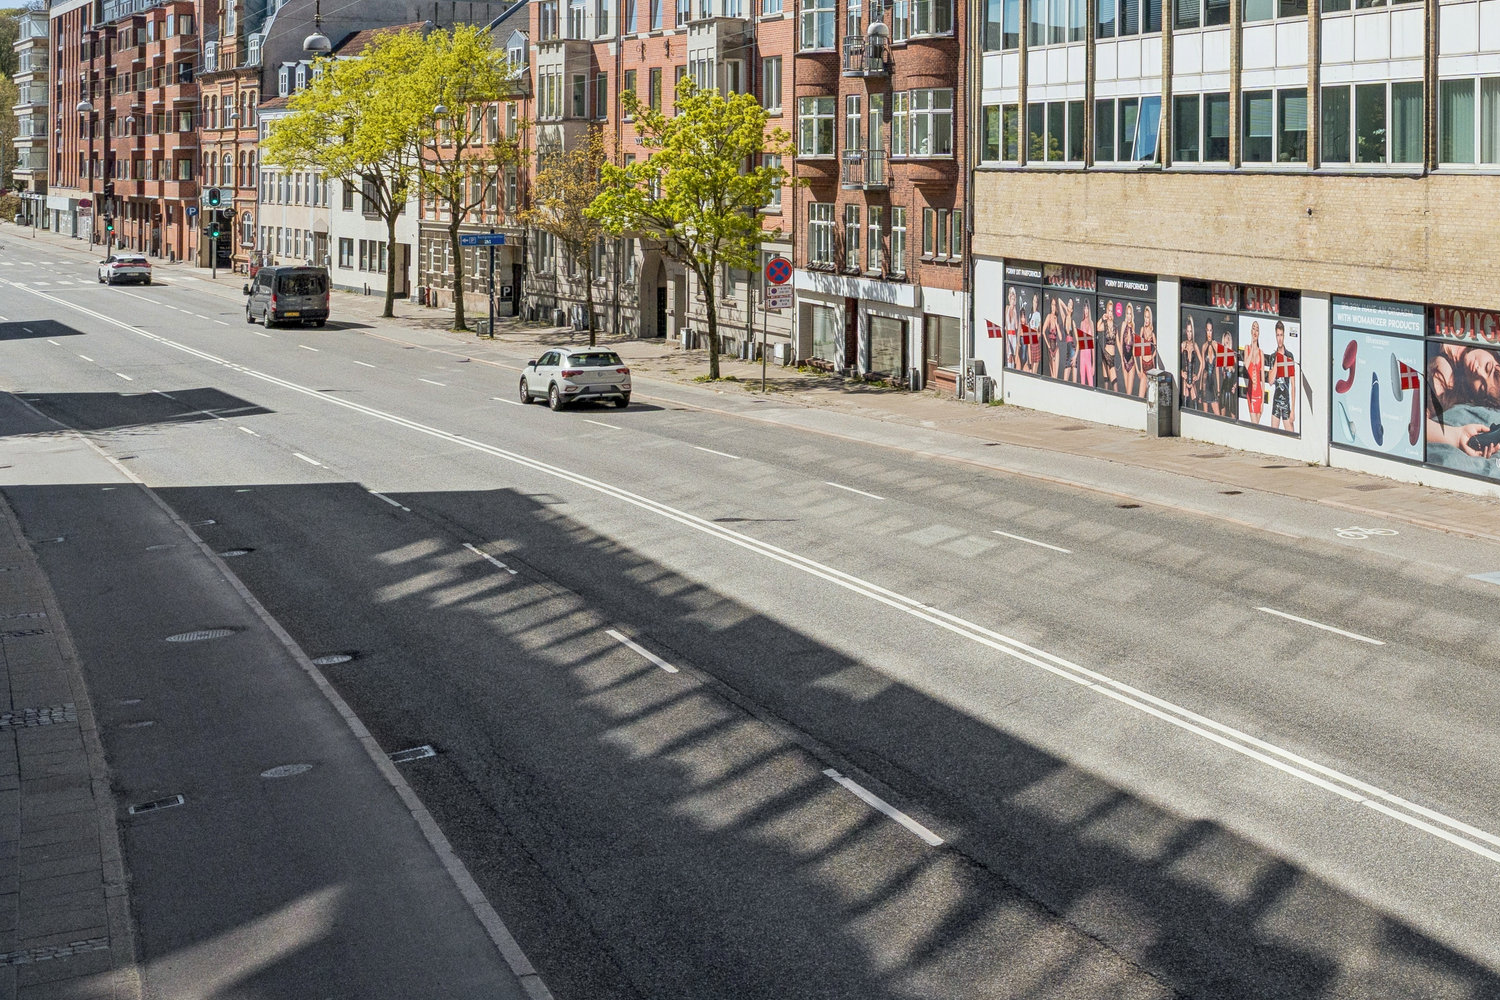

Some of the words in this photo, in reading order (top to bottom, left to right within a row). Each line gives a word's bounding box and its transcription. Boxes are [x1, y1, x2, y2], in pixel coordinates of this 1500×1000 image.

[503, 286, 511, 297] P
[1337, 312, 1351, 322] WITH
[1352, 314, 1387, 327] WOMANIZER
[1388, 319, 1421, 332] PRODUCTS
